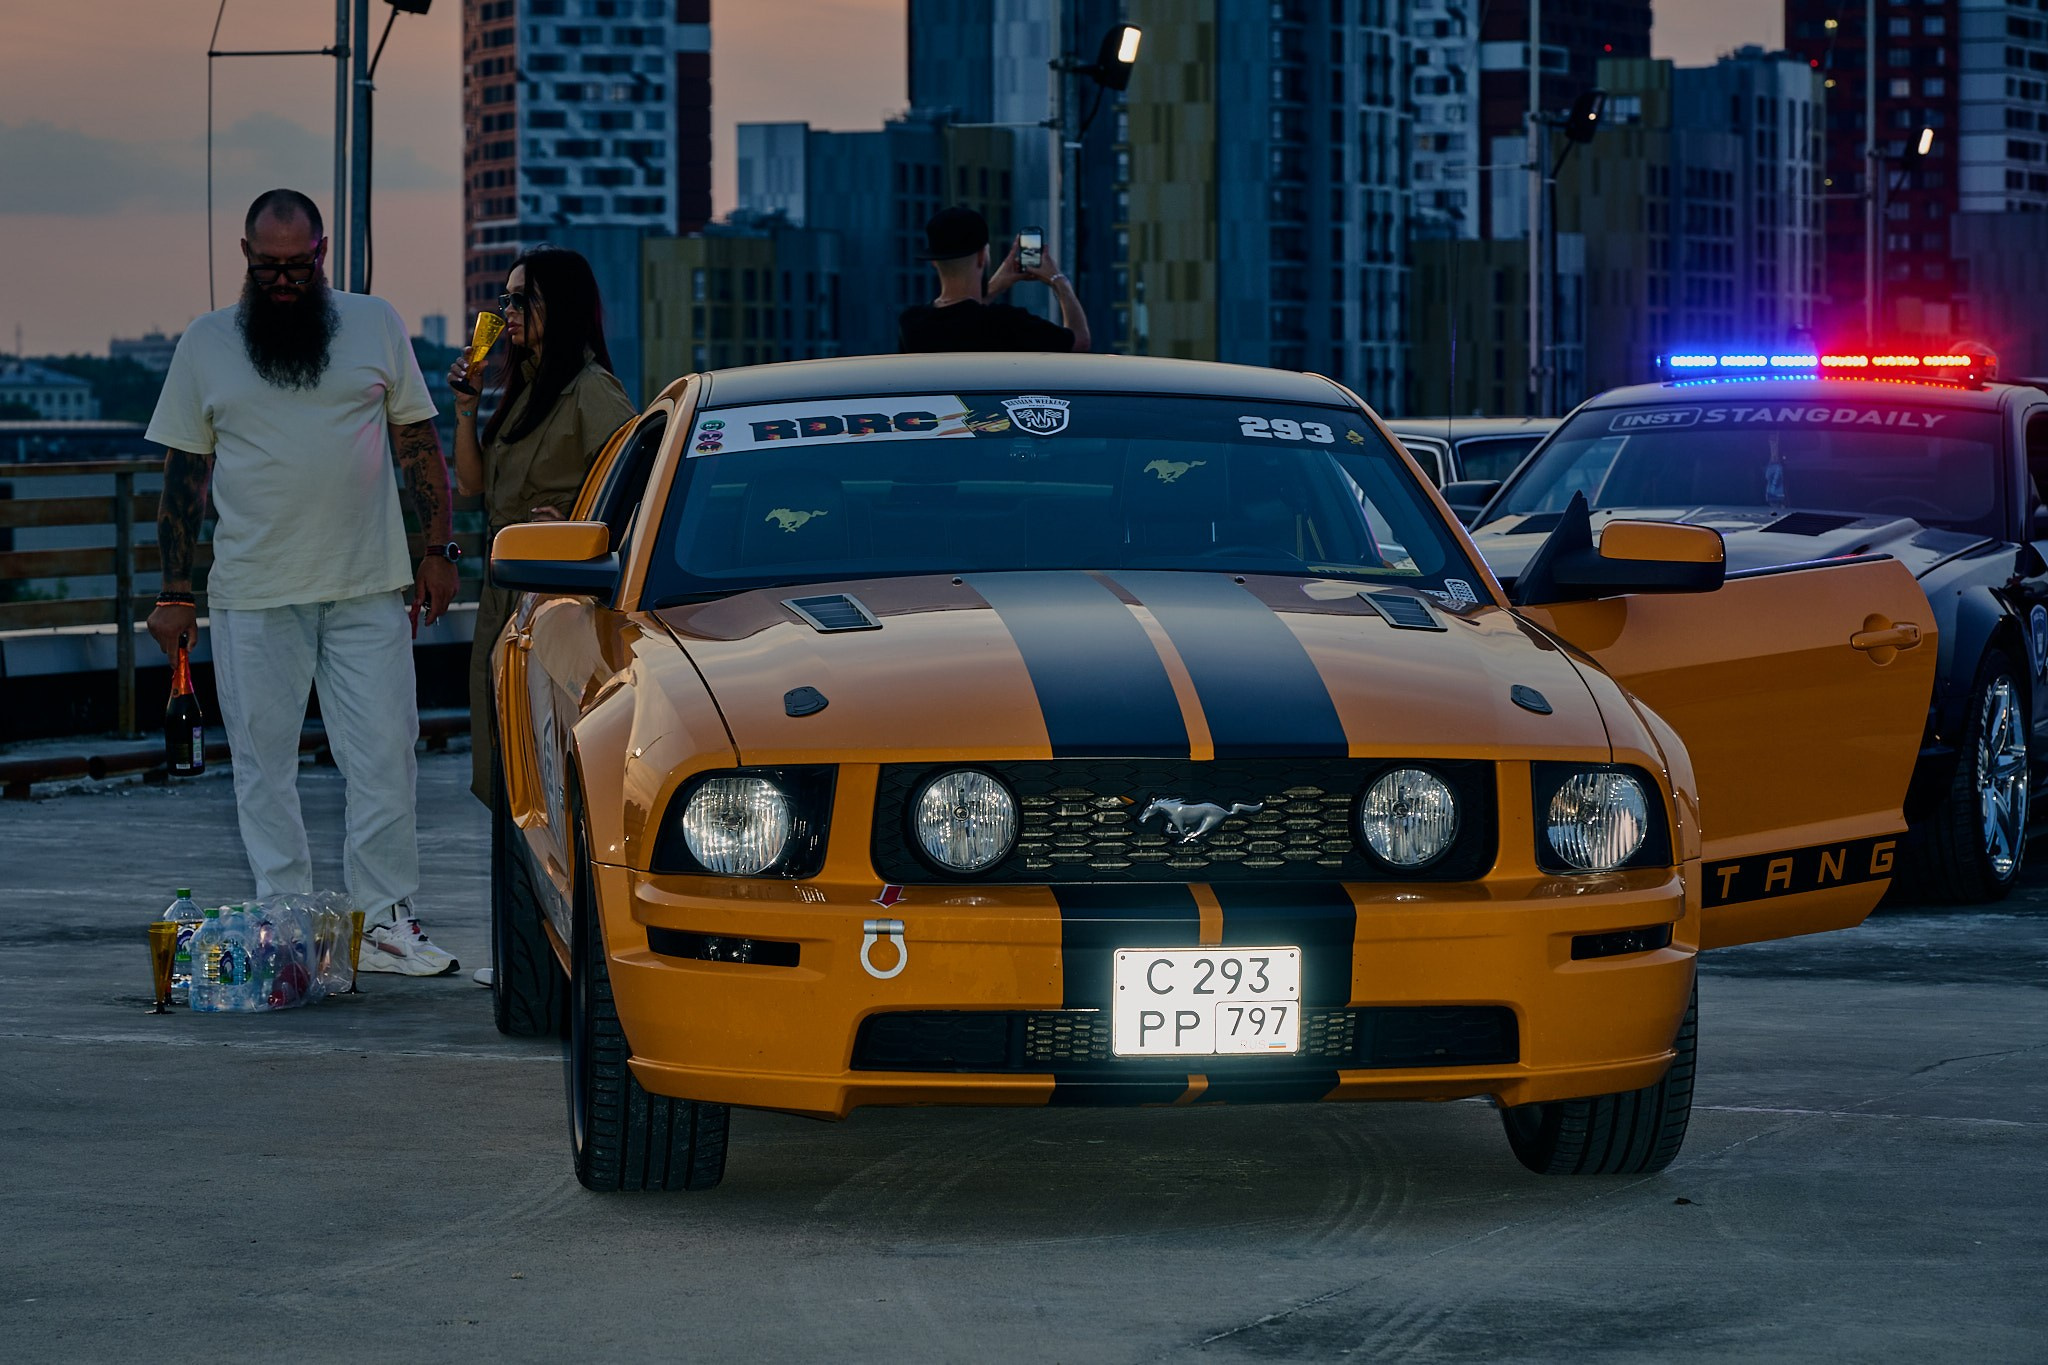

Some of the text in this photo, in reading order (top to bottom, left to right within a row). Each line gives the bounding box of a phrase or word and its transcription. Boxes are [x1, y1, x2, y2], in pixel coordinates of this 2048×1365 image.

[748, 411, 939, 442] RDRC
[1238, 415, 1335, 444] 293
[1622, 412, 1690, 427] INST
[1703, 407, 1947, 428] STANGDAILY
[1192, 957, 1270, 995] 293
[1227, 1006, 1288, 1036] 797
